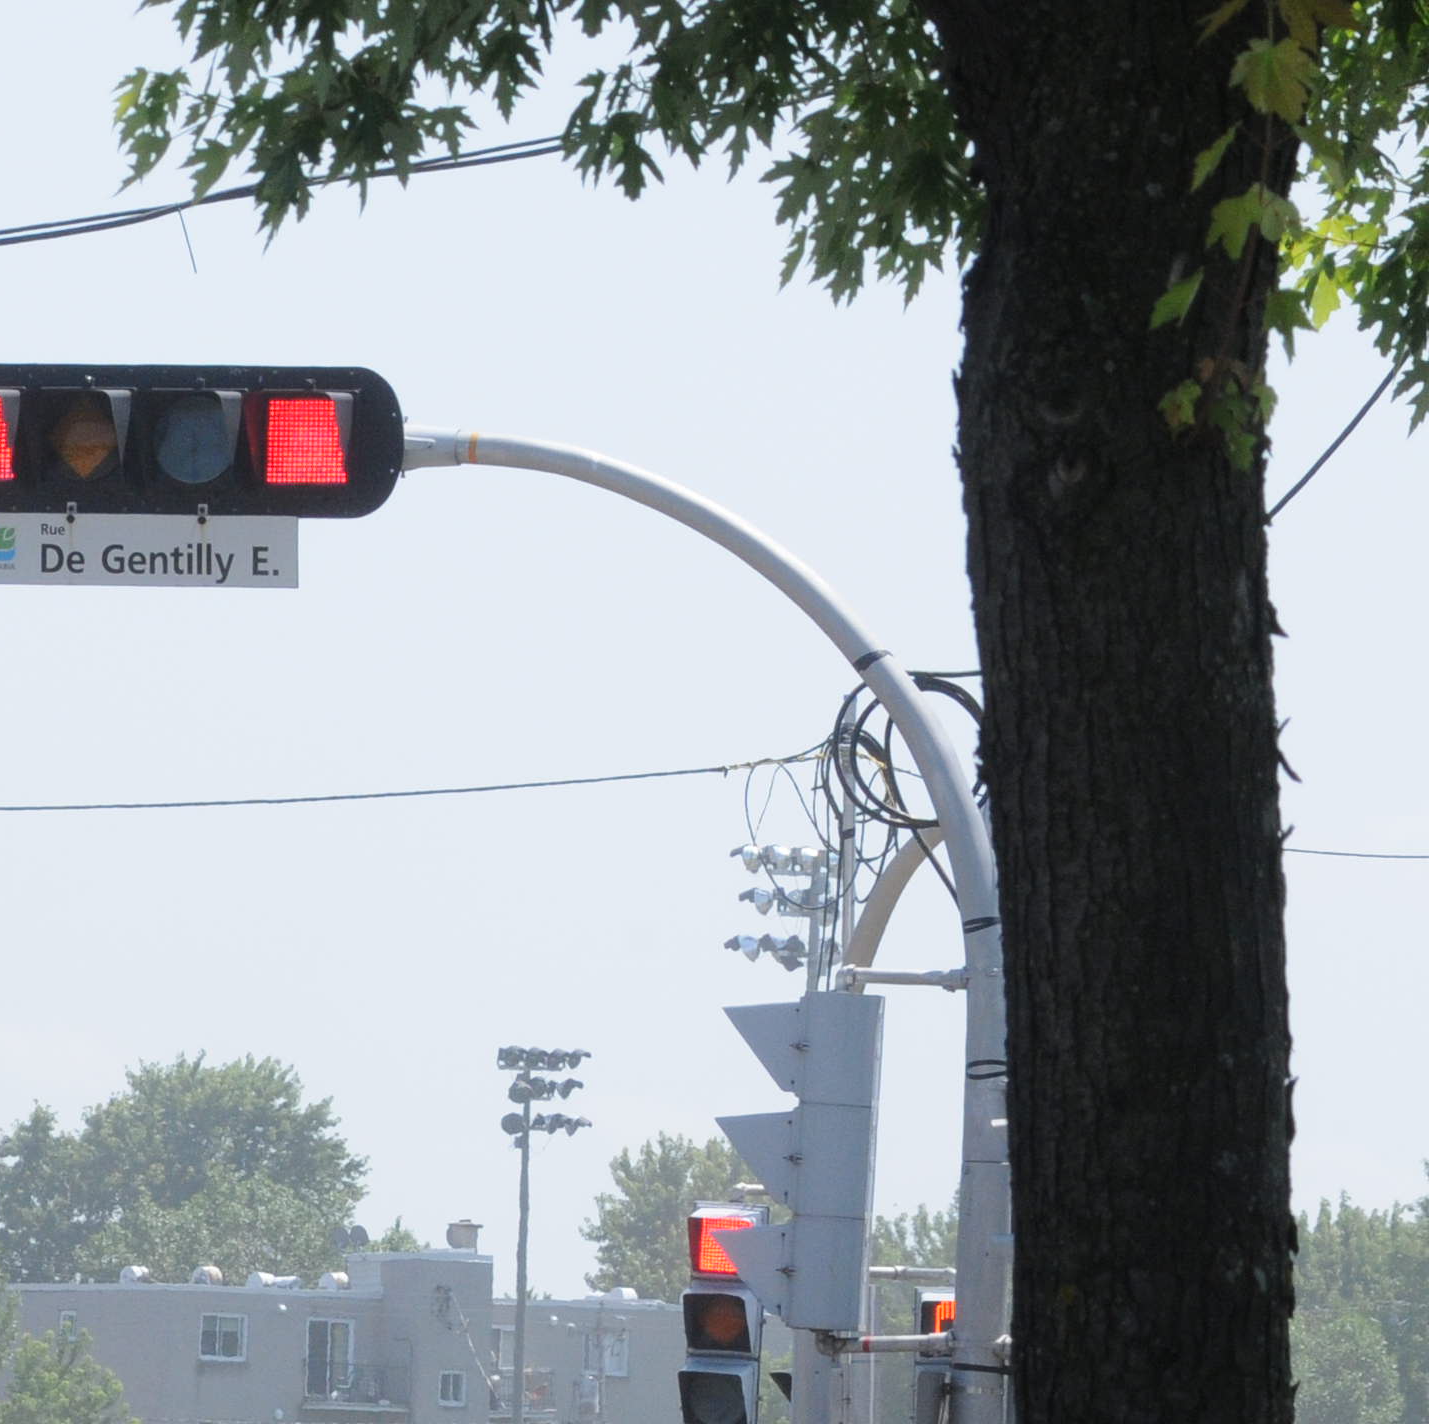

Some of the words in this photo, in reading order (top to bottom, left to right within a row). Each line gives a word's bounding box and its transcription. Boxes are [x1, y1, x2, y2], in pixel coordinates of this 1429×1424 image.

[41, 523, 66, 536] Rue
[40, 543, 86, 574] De
[101, 543, 235, 584] Gentilly
[251, 546, 280, 577] E.
